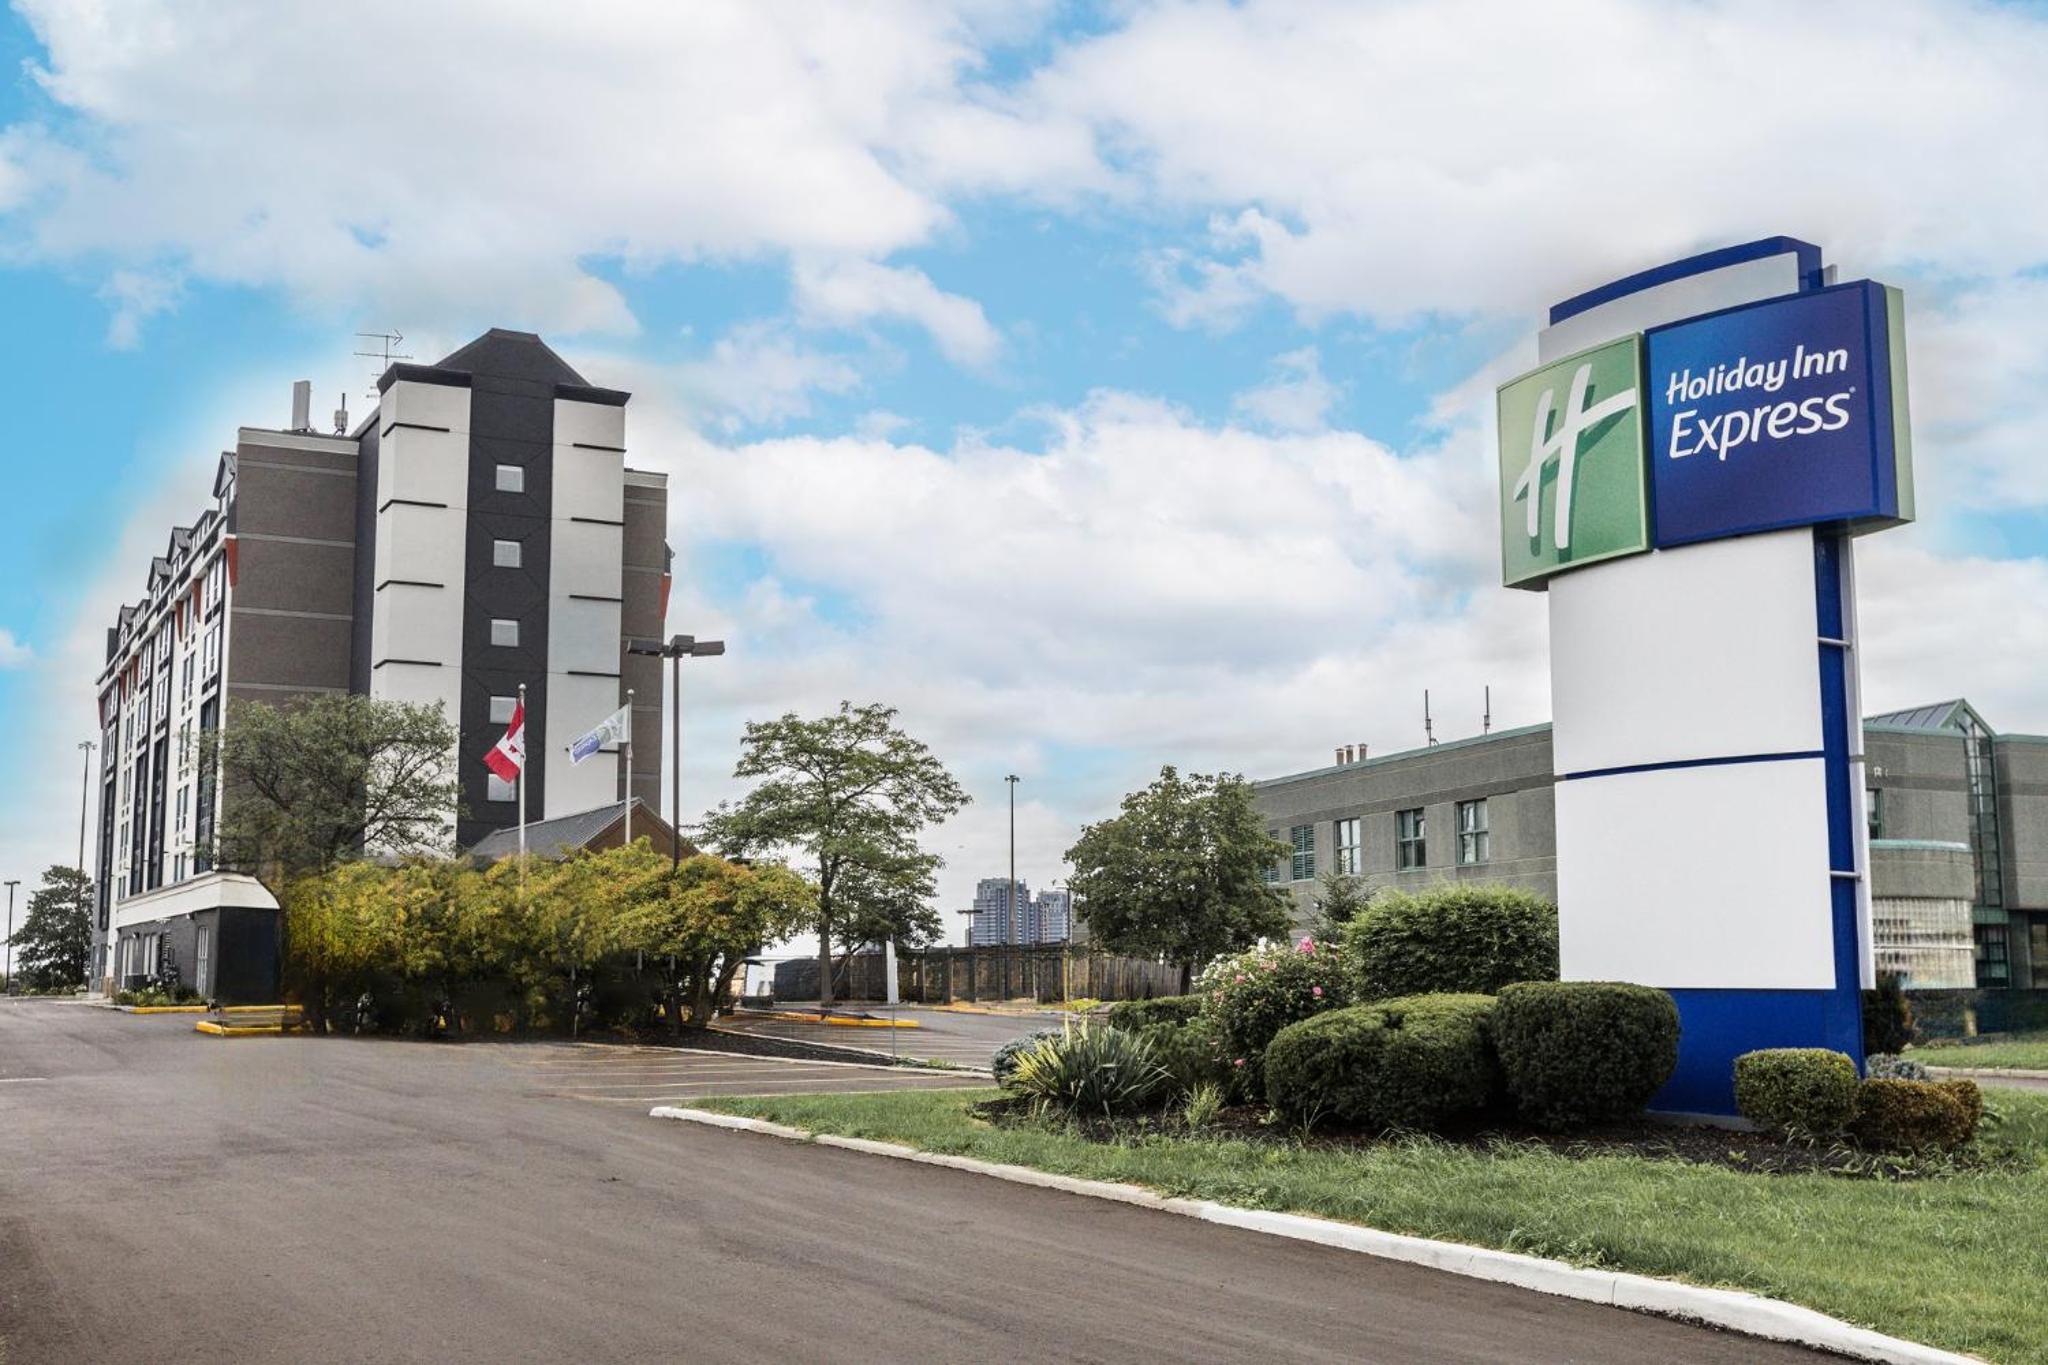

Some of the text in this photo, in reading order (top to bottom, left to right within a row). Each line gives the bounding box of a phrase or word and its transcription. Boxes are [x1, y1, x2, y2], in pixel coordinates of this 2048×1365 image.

[1666, 345, 1848, 404] Holiday Inn
[1513, 363, 1636, 549] H
[1669, 392, 1851, 461] Express
